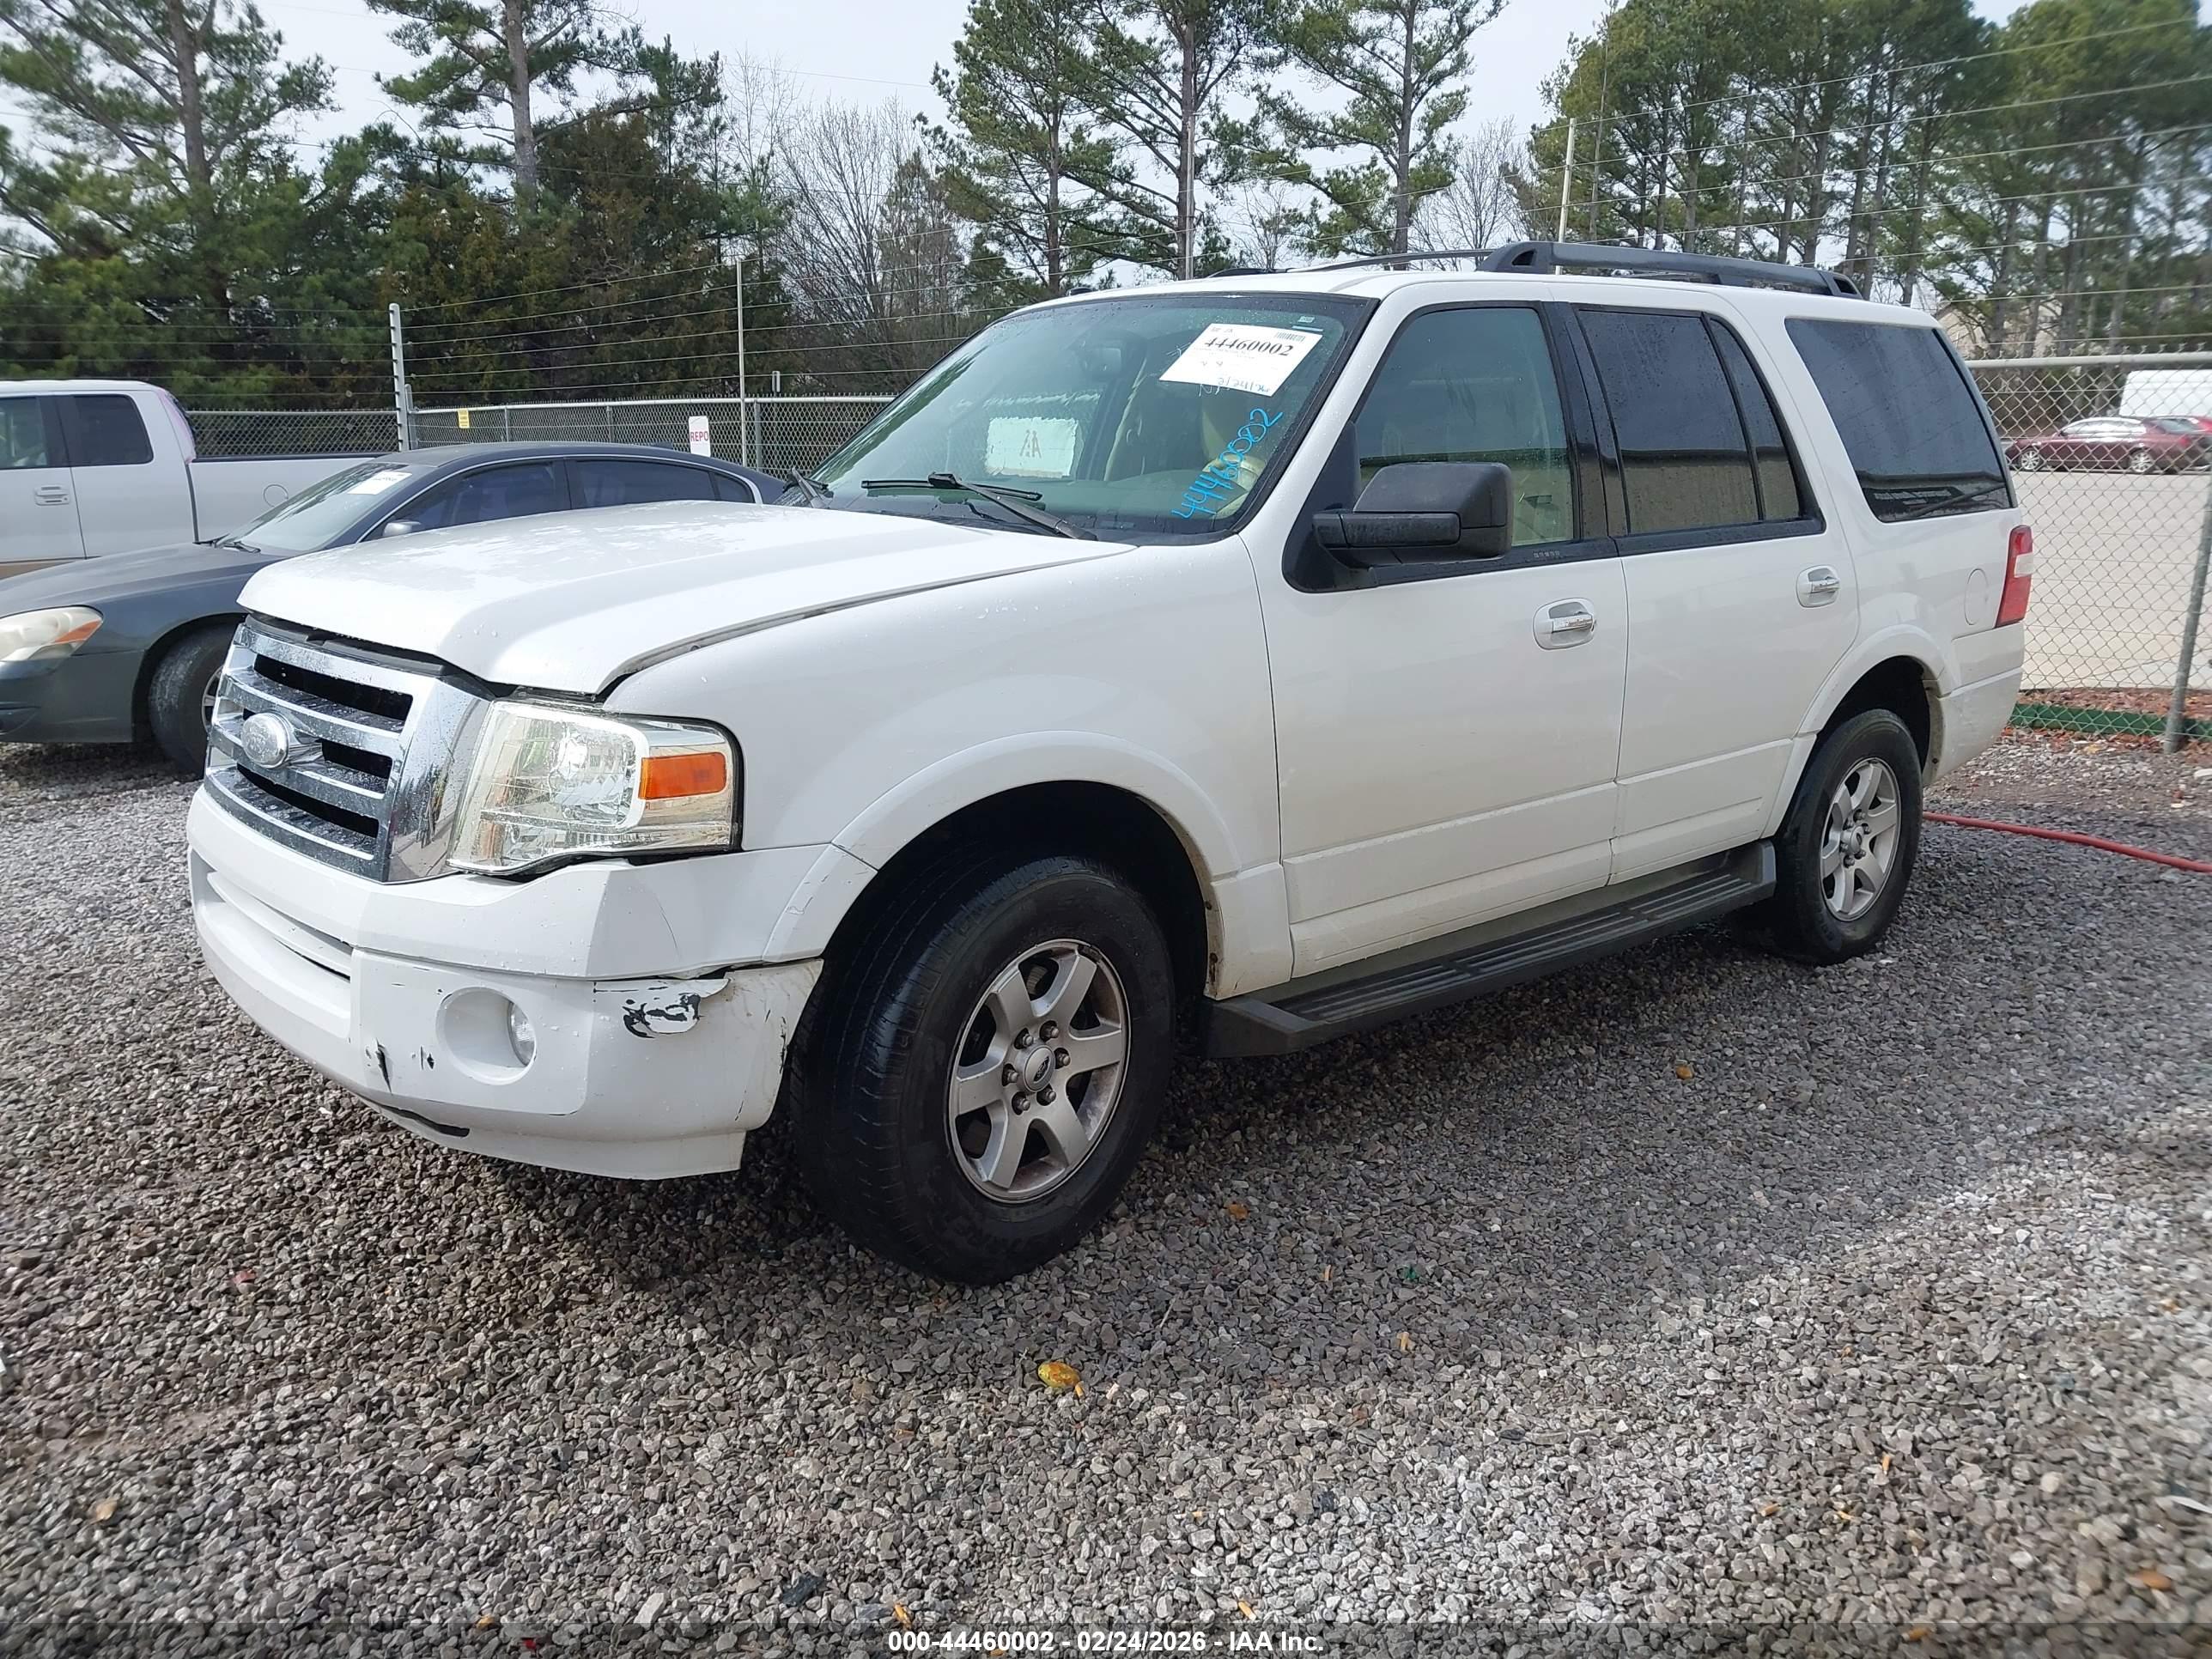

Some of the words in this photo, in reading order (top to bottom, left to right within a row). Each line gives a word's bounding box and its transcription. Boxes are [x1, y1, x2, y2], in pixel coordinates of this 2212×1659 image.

[1205, 337, 1294, 357] 44460002
[690, 430, 709, 442] REPO
[1171, 408, 1285, 519] 44460002
